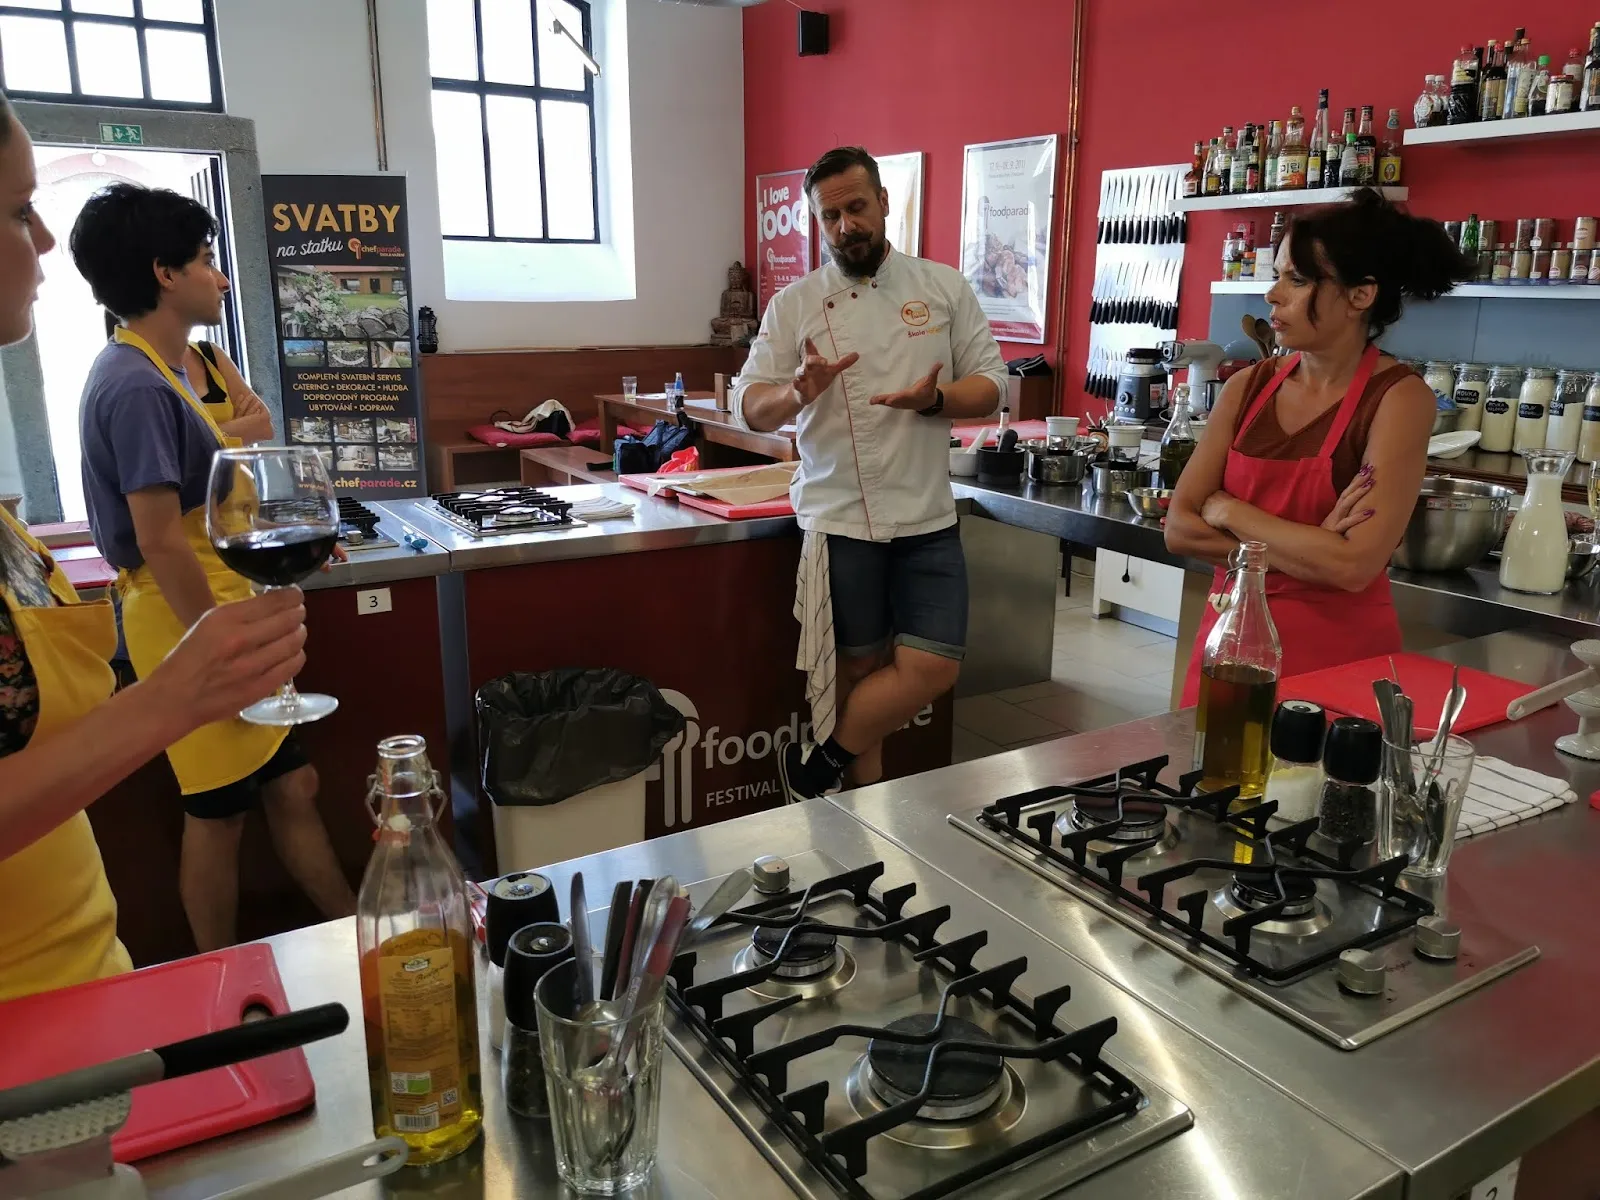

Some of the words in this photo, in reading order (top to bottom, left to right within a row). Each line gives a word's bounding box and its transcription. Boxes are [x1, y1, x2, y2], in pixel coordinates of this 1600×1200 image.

[763, 189, 768, 208] I
[769, 186, 790, 206] love
[272, 203, 401, 233] SVATBY
[989, 204, 1030, 219] foodparad
[276, 245, 298, 258] na
[299, 237, 344, 256] statku
[361, 245, 402, 255] chefparade
[297, 372, 340, 381] KOMPLETNÍ
[341, 372, 376, 381] SVATEBNÍ
[377, 373, 402, 382] SERVIS
[292, 383, 330, 391] CATERING
[336, 384, 376, 392] DEKORACE
[382, 384, 409, 392] HUDBA
[303, 392, 359, 401] DOPROVODNÝ
[360, 393, 399, 402] PROGRAM
[308, 402, 353, 411] UBYTOVÁNÍ
[359, 404, 396, 412] DOPRAVA
[369, 595, 378, 608] 3
[706, 780, 781, 808] FESTIVAL
